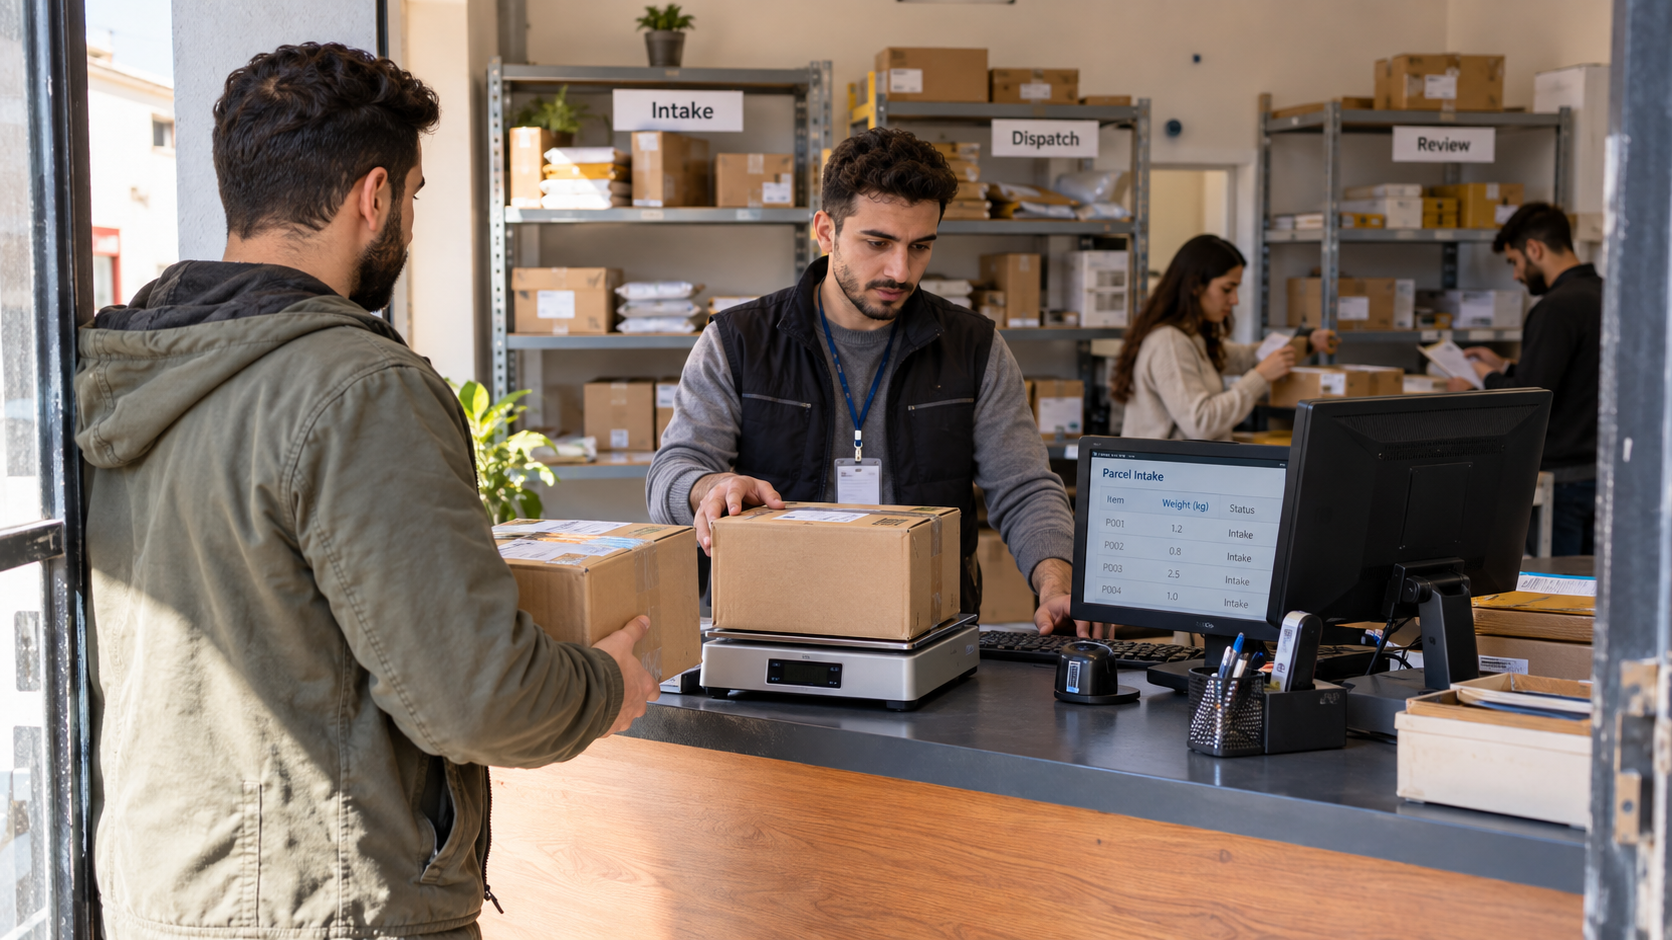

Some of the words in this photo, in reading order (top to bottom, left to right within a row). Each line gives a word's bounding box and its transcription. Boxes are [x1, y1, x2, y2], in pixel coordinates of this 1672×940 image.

[652, 101, 714, 119] Intake
[1012, 130, 1080, 149] Dispatch
[1417, 136, 1471, 152] Review
[1102, 468, 1132, 480] Parcel
[1134, 470, 1164, 482] Intake
[1107, 495, 1124, 504] Item
[1162, 498, 1190, 511] Weight
[1193, 501, 1209, 512] (kg)
[1229, 504, 1255, 514] Status
[1106, 518, 1125, 528] P001
[1171, 524, 1182, 533] 1.2
[1228, 529, 1254, 539] Intake
[1104, 541, 1124, 550] P002
[1169, 546, 1182, 556] 0.8
[1227, 552, 1252, 563] Intake
[1103, 563, 1123, 573] P003
[1167, 569, 1180, 578] 2.5
[1225, 576, 1250, 586] Intake
[1101, 585, 1121, 594] P004
[1167, 591, 1178, 601] 1.0
[1224, 598, 1249, 609] Intake
